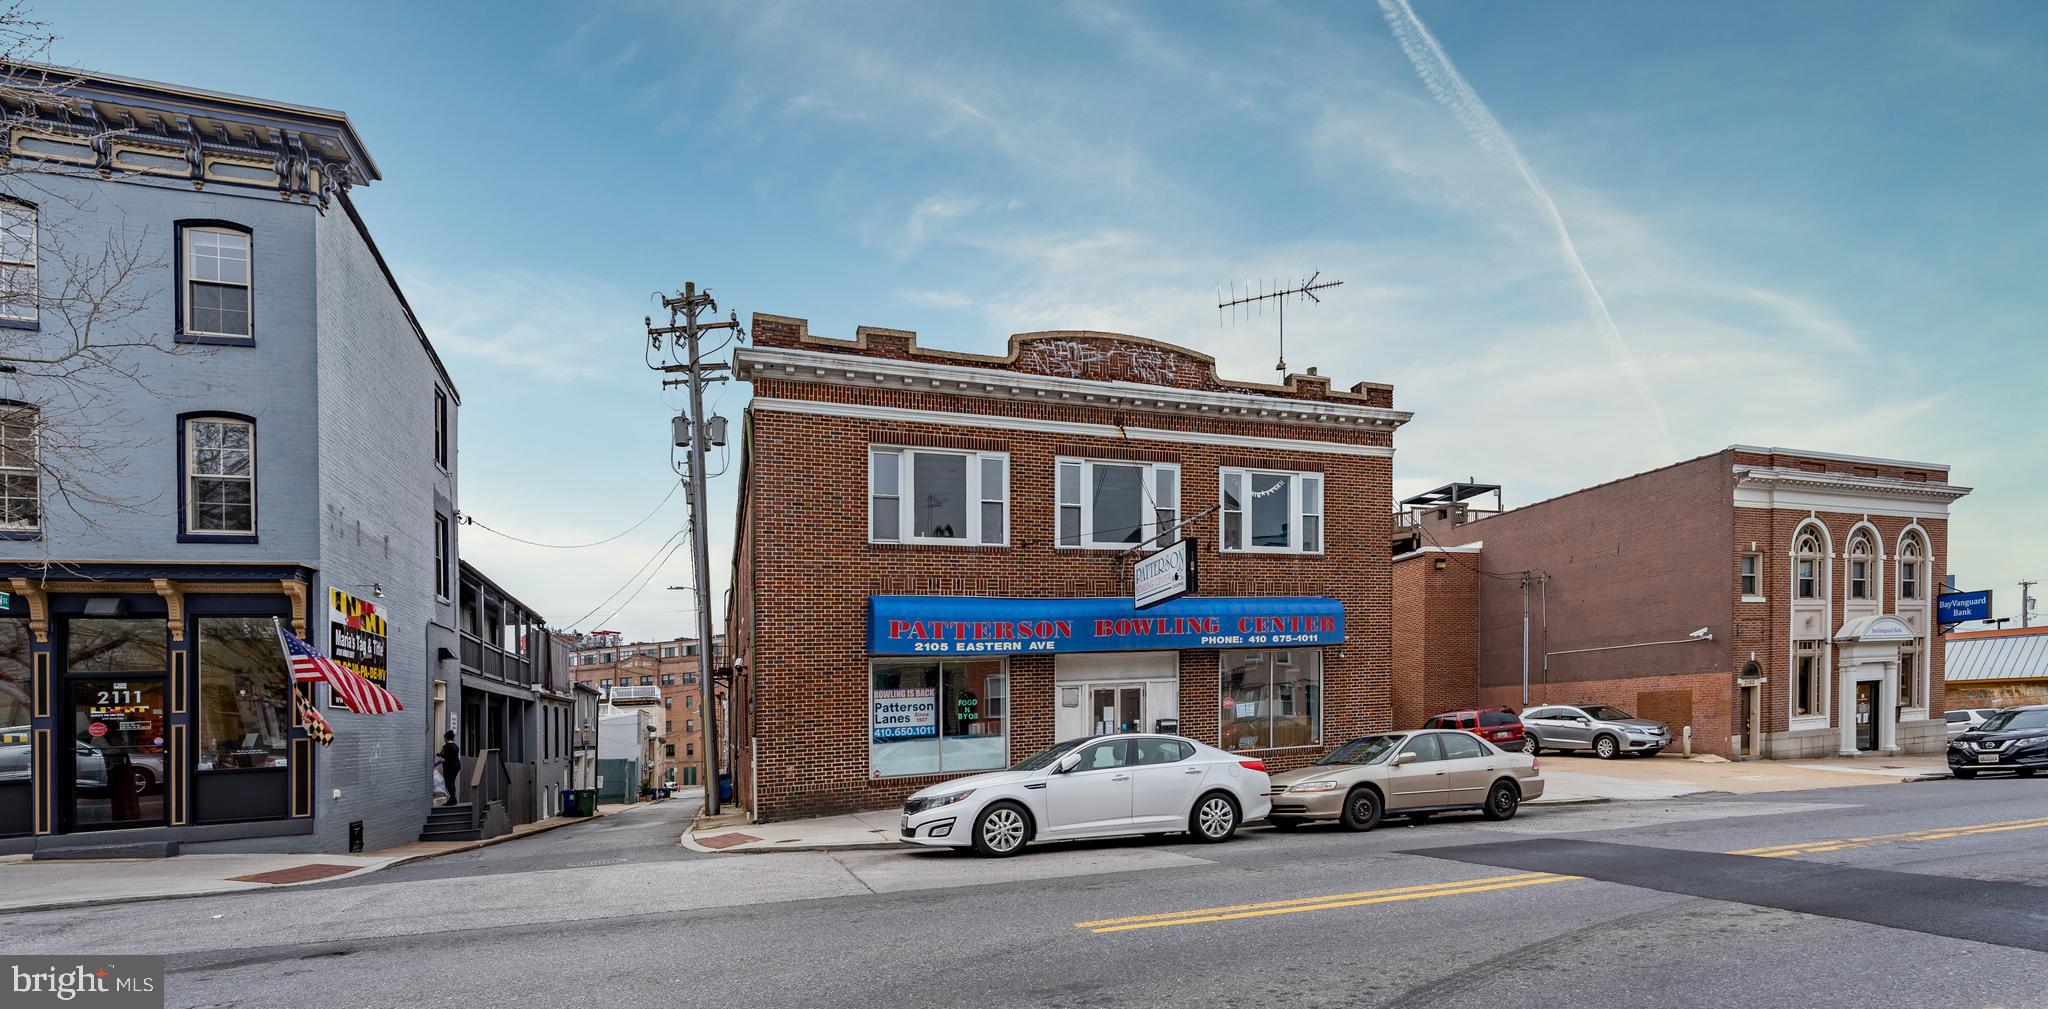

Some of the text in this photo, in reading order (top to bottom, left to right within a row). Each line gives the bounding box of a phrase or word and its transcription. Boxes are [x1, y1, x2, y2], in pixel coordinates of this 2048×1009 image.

[1136, 548, 1184, 584] PATTERSON
[1939, 596, 1986, 608] BayVanguard
[1953, 608, 1972, 616] Bank
[888, 616, 1336, 640] PATTERSON BOWLING CENTER
[1201, 634, 1318, 644] PHONE: 410 675-1011
[915, 641, 1055, 651] 2105 EASTERN AVE
[97, 690, 141, 704] 2111
[874, 688, 935, 699] BOWLING IS BACK
[875, 702, 934, 713] Patterson
[875, 714, 911, 724] Lanes
[874, 726, 936, 737] 410.650.1011
